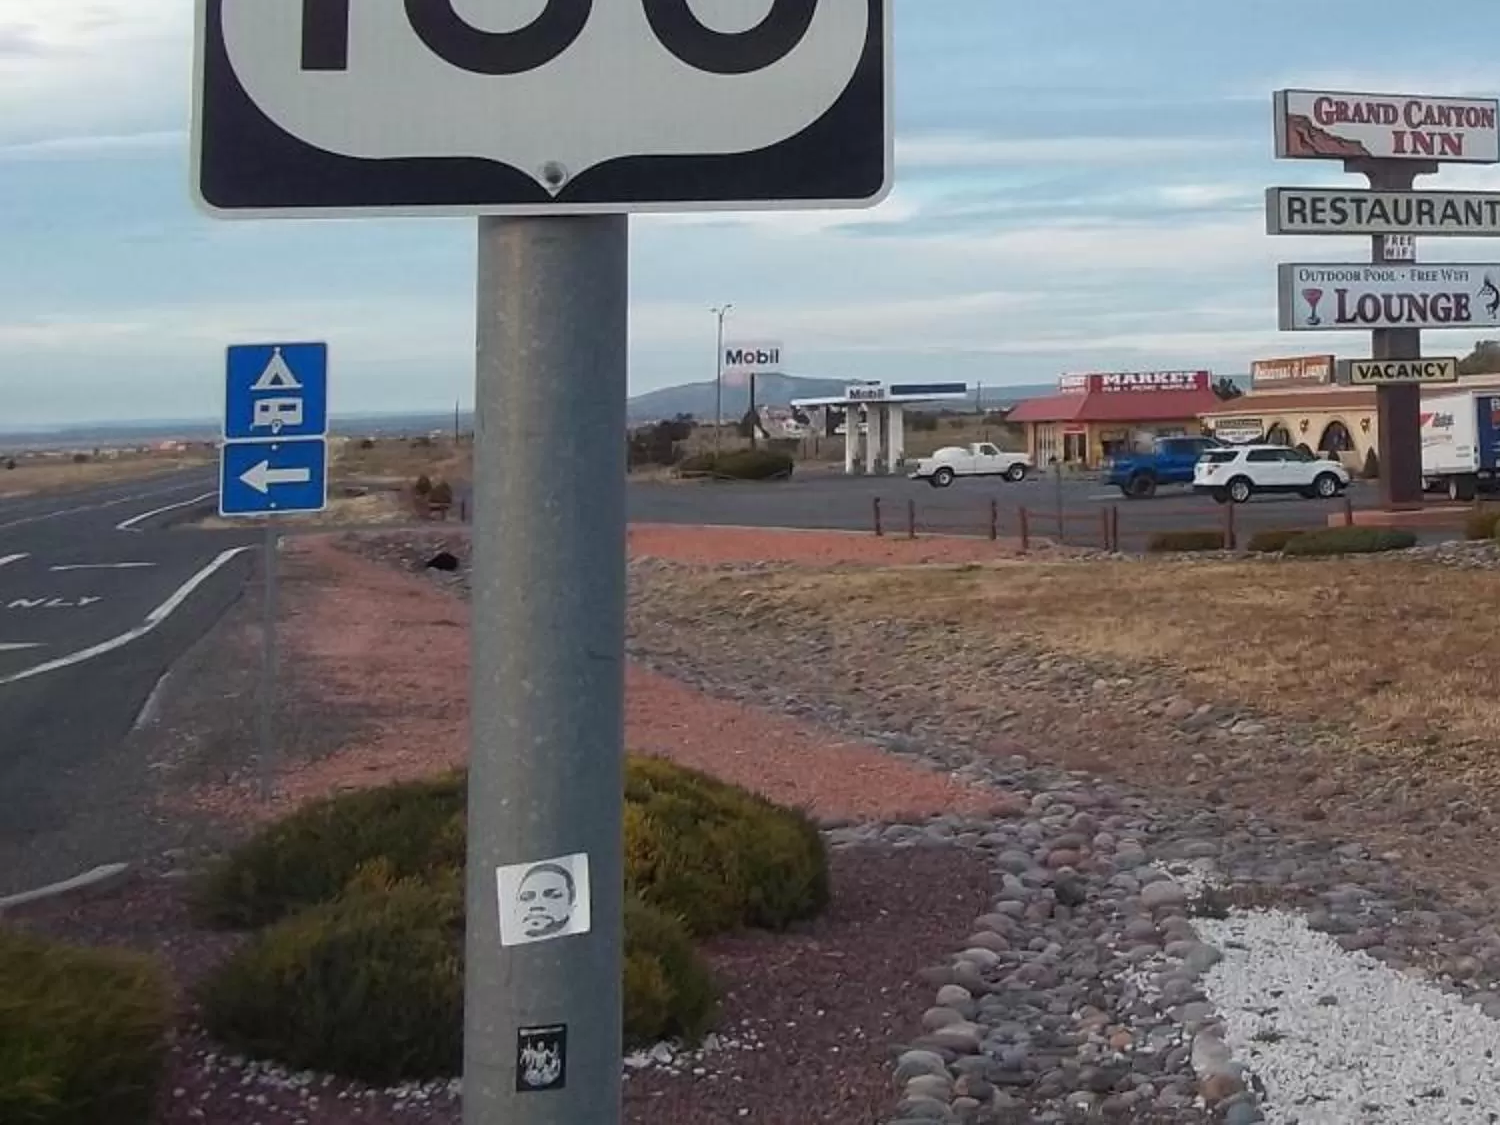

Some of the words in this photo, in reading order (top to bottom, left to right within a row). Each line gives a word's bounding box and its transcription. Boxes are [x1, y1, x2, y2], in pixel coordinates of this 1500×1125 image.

[1313, 96, 1398, 126] GRAND
[1403, 100, 1495, 129] CANYON
[1391, 130, 1465, 156] INN
[1299, 269, 1361, 282] OUTDOOR
[1363, 269, 1396, 282] POOL
[1410, 269, 1439, 282] FREE
[1334, 288, 1471, 324] LOUNGE
[725, 348, 780, 365] Mobil
[1102, 372, 1197, 386] MARKET
[1357, 362, 1449, 380] VACANCY
[849, 388, 885, 399] Mobil
[0, 596, 102, 608] NLY
